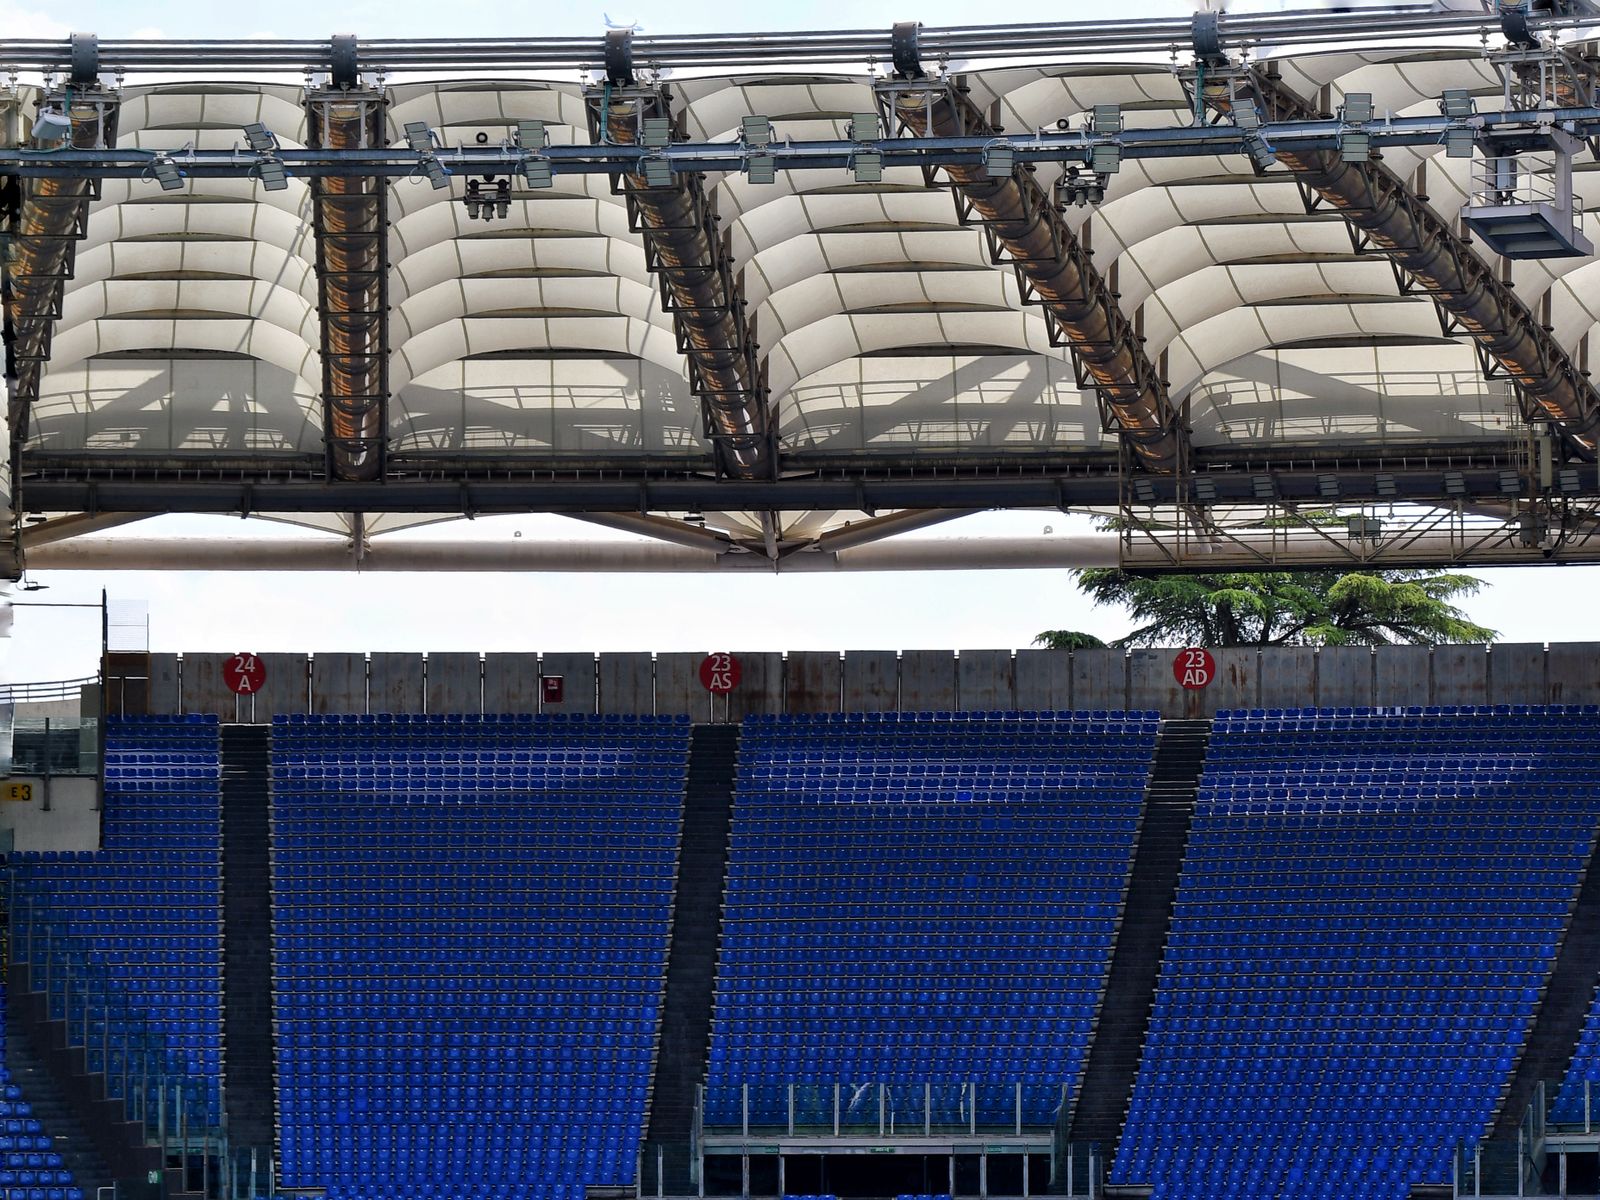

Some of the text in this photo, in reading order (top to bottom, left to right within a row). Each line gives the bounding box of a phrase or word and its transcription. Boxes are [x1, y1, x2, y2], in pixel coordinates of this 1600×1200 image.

[235, 656, 255, 672] 24
[711, 655, 731, 672] 23
[1185, 651, 1205, 667] 23
[238, 674, 252, 691] A
[709, 672, 732, 689] AS
[1182, 669, 1208, 685] AD
